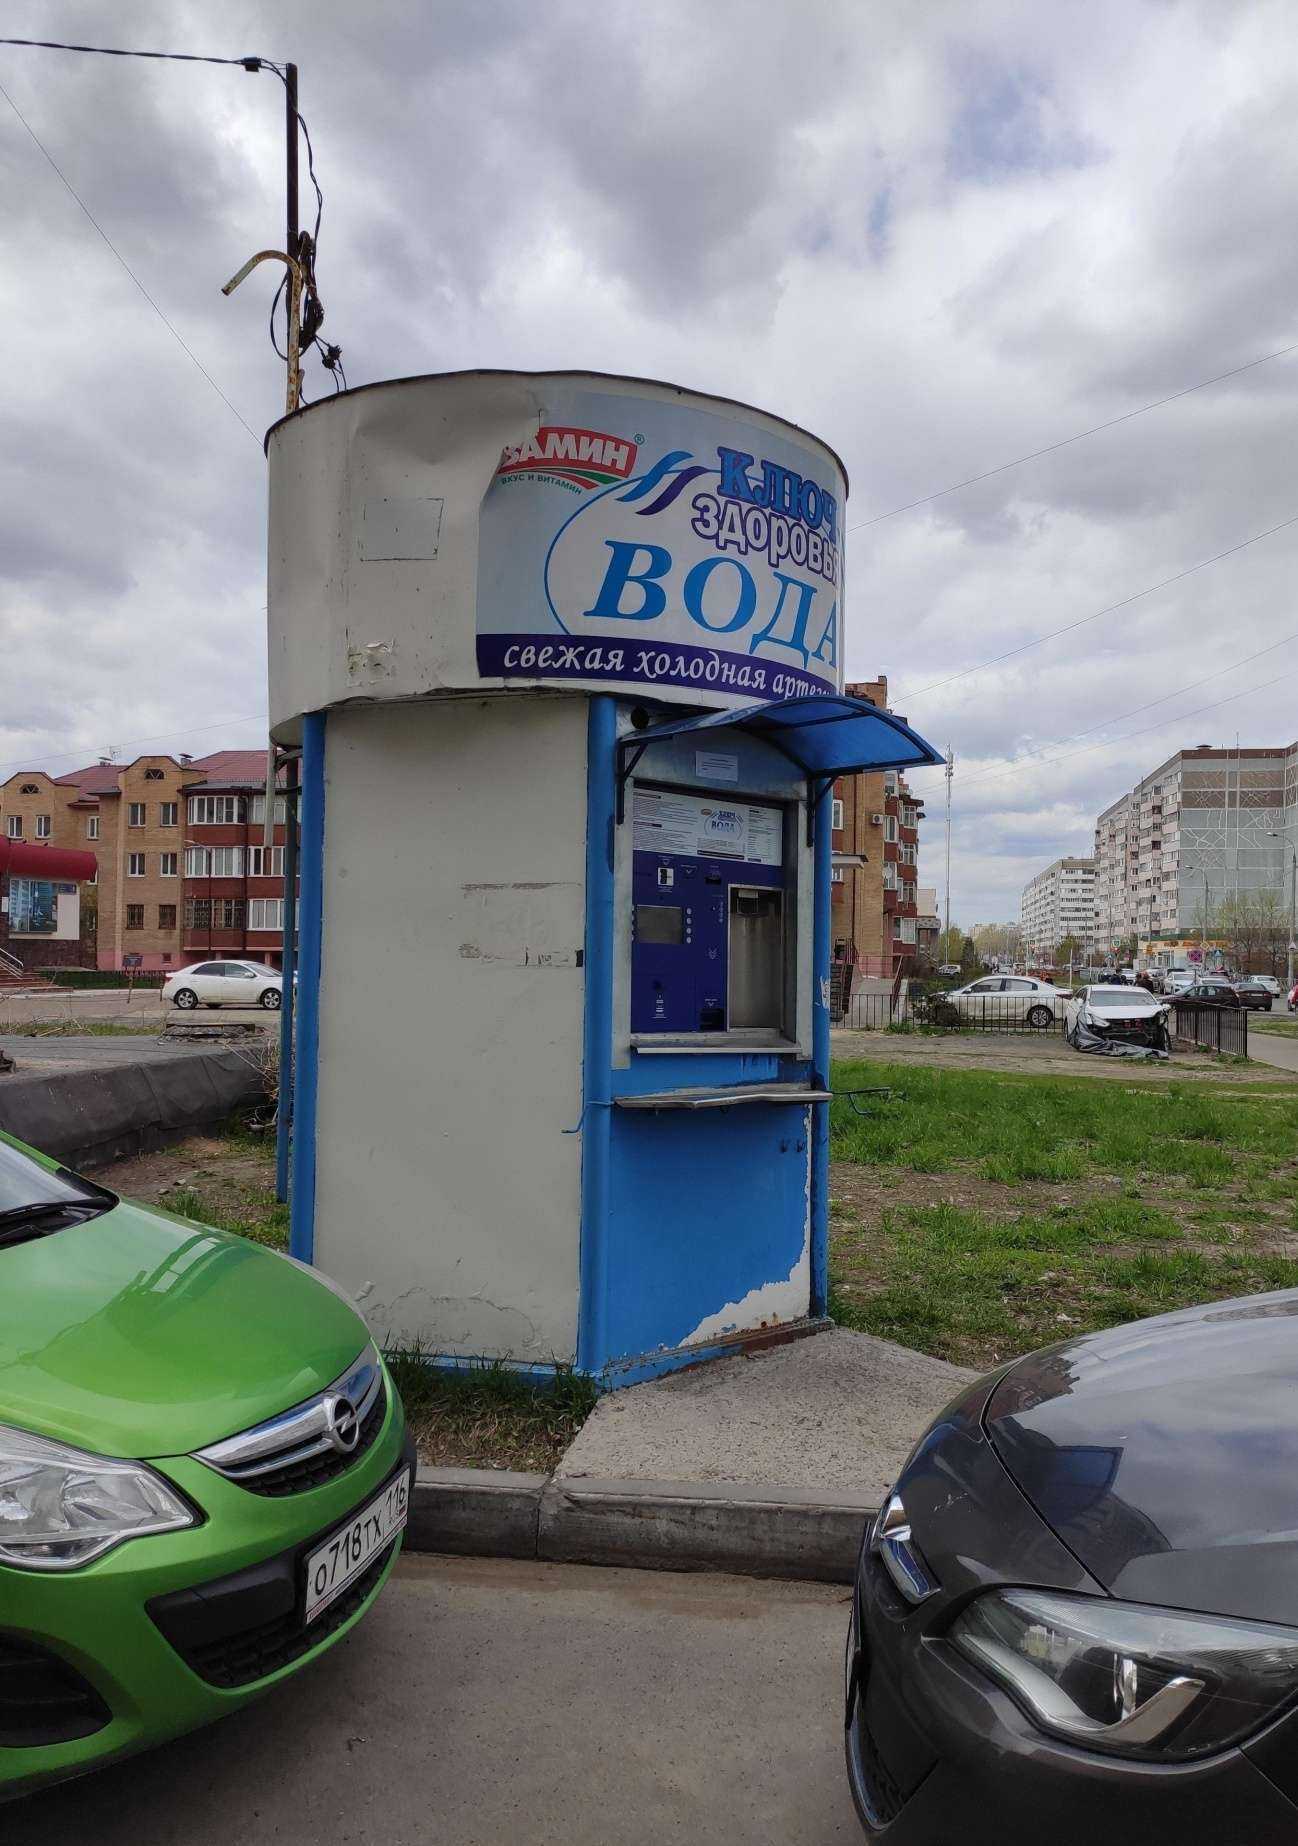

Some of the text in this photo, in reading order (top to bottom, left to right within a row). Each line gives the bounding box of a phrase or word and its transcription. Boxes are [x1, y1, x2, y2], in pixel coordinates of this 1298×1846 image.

[502, 474, 582, 495] ВКУС И ВИТАМИН
[717, 446, 838, 546] КЛЮЧ
[583, 540, 838, 669] ВОДА
[504, 645, 625, 671] свежая
[633, 650, 767, 690] холодная
[386, 1477, 406, 1516] 116
